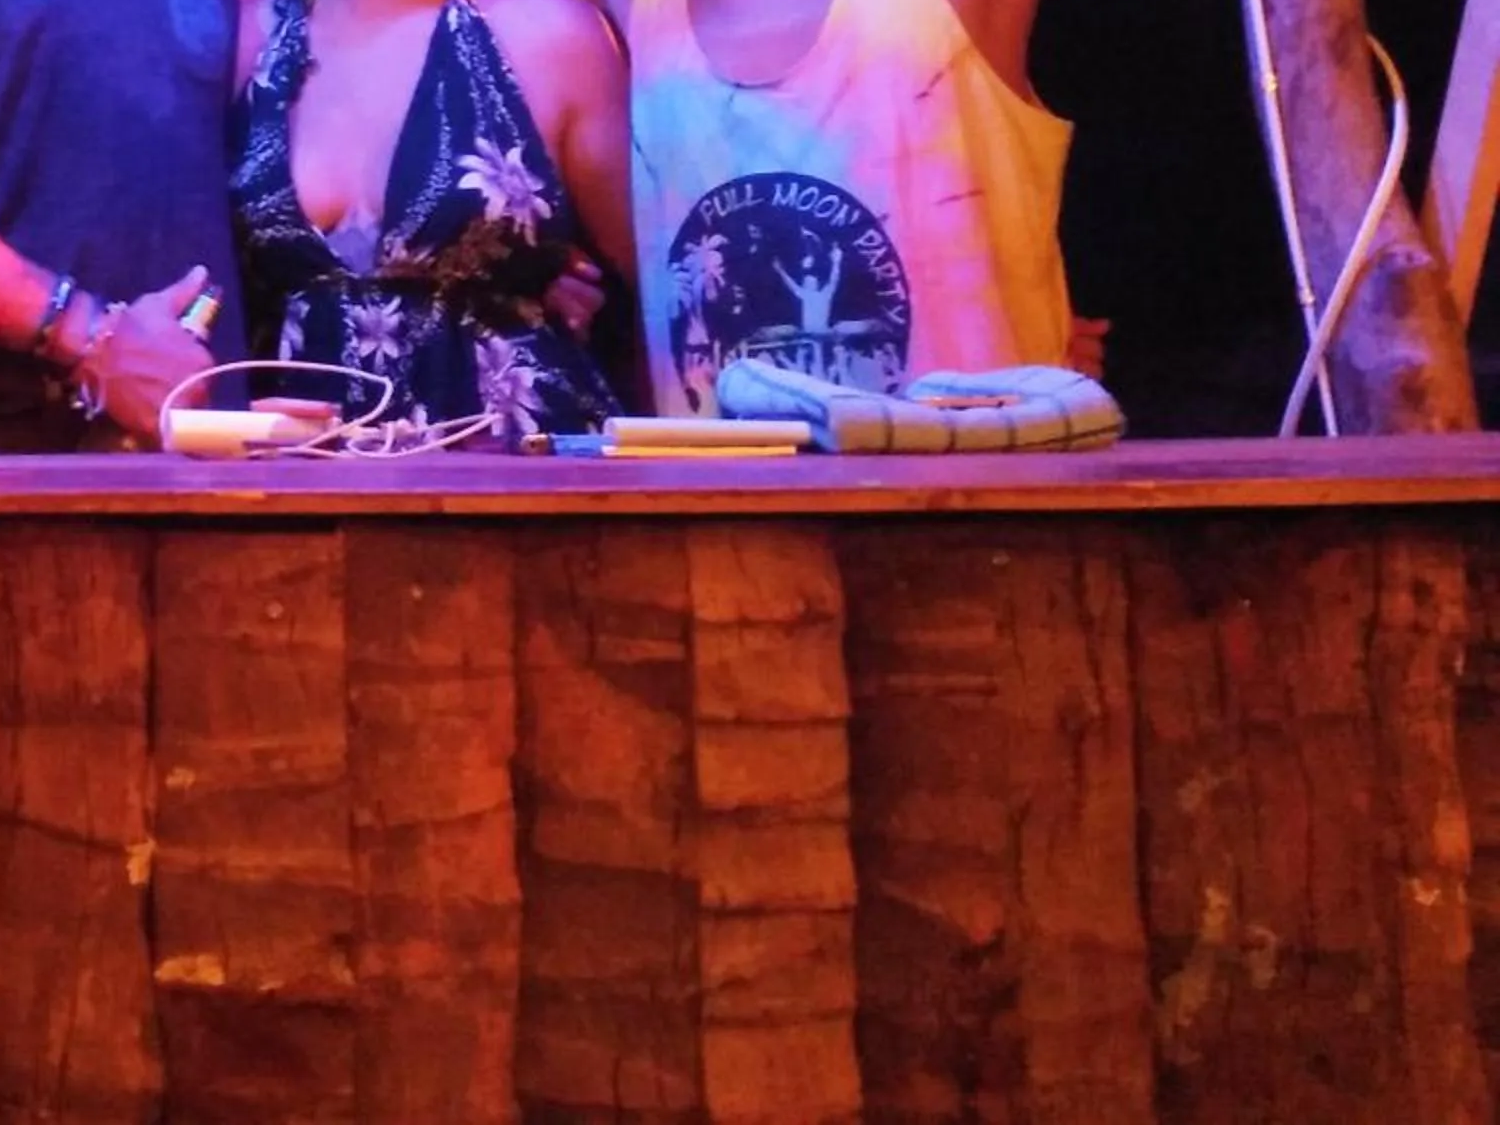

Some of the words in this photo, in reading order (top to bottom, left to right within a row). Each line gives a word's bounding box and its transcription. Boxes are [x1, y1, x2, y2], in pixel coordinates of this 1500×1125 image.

[699, 183, 765, 226] FULL
[771, 182, 861, 227] MOON
[852, 228, 907, 325] PARTY
